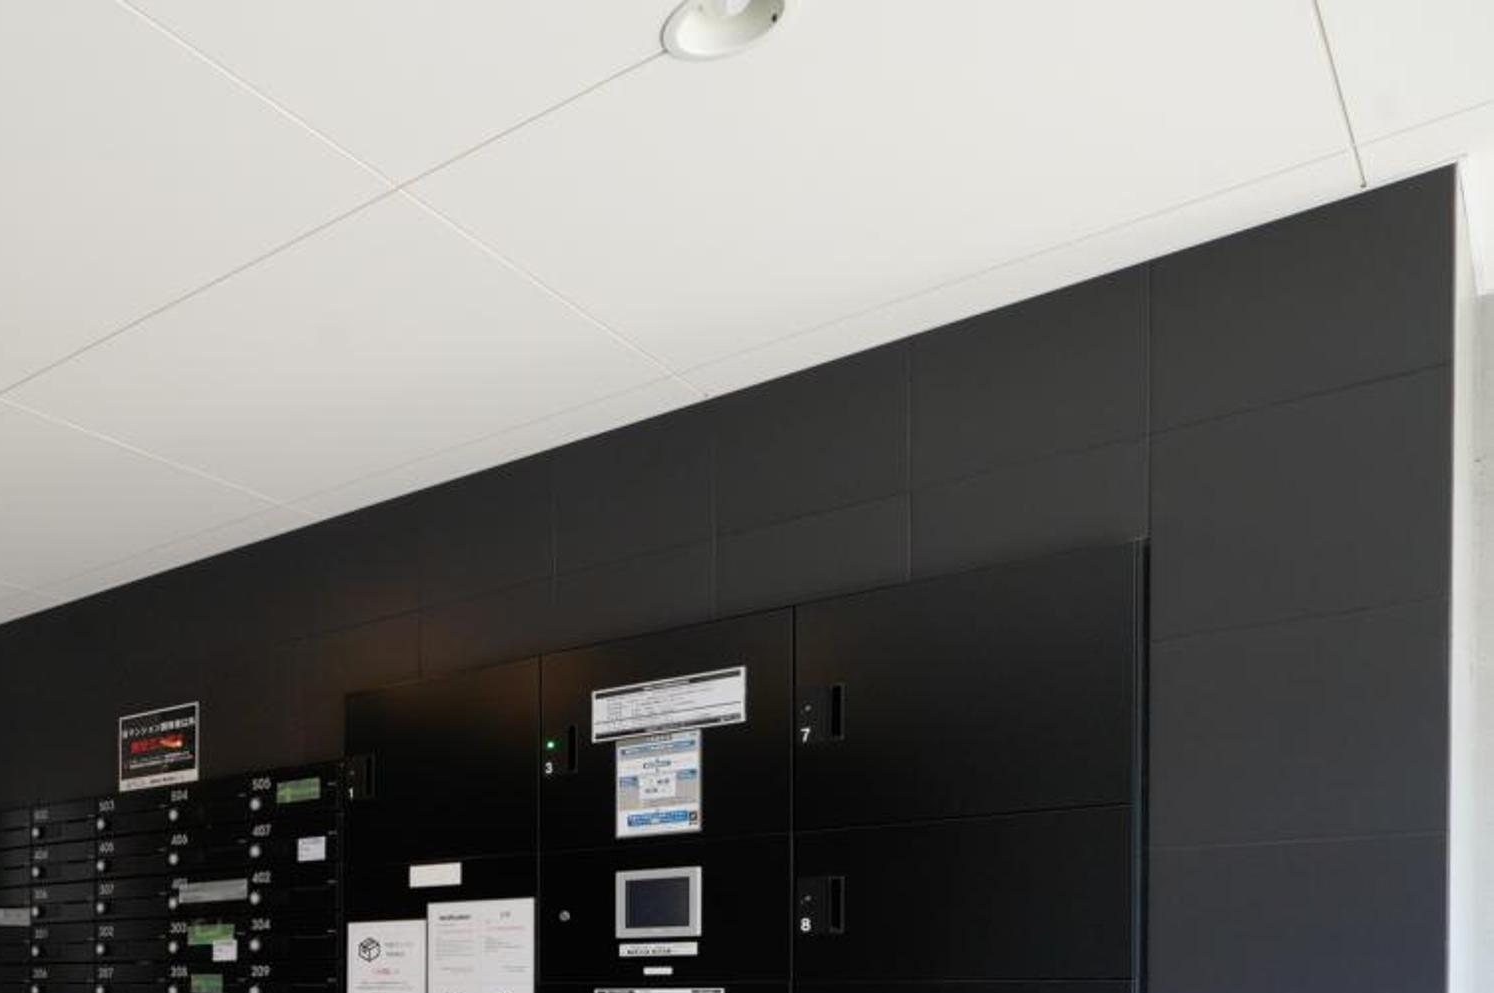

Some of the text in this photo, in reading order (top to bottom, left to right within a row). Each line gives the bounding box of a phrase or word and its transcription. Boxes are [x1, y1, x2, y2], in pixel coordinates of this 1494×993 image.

[800, 727, 811, 743] 7
[545, 761, 554, 775] 3
[348, 787, 354, 799] 1
[252, 918, 270, 930] 304
[800, 917, 812, 932] 8
[251, 965, 270, 977] 209
